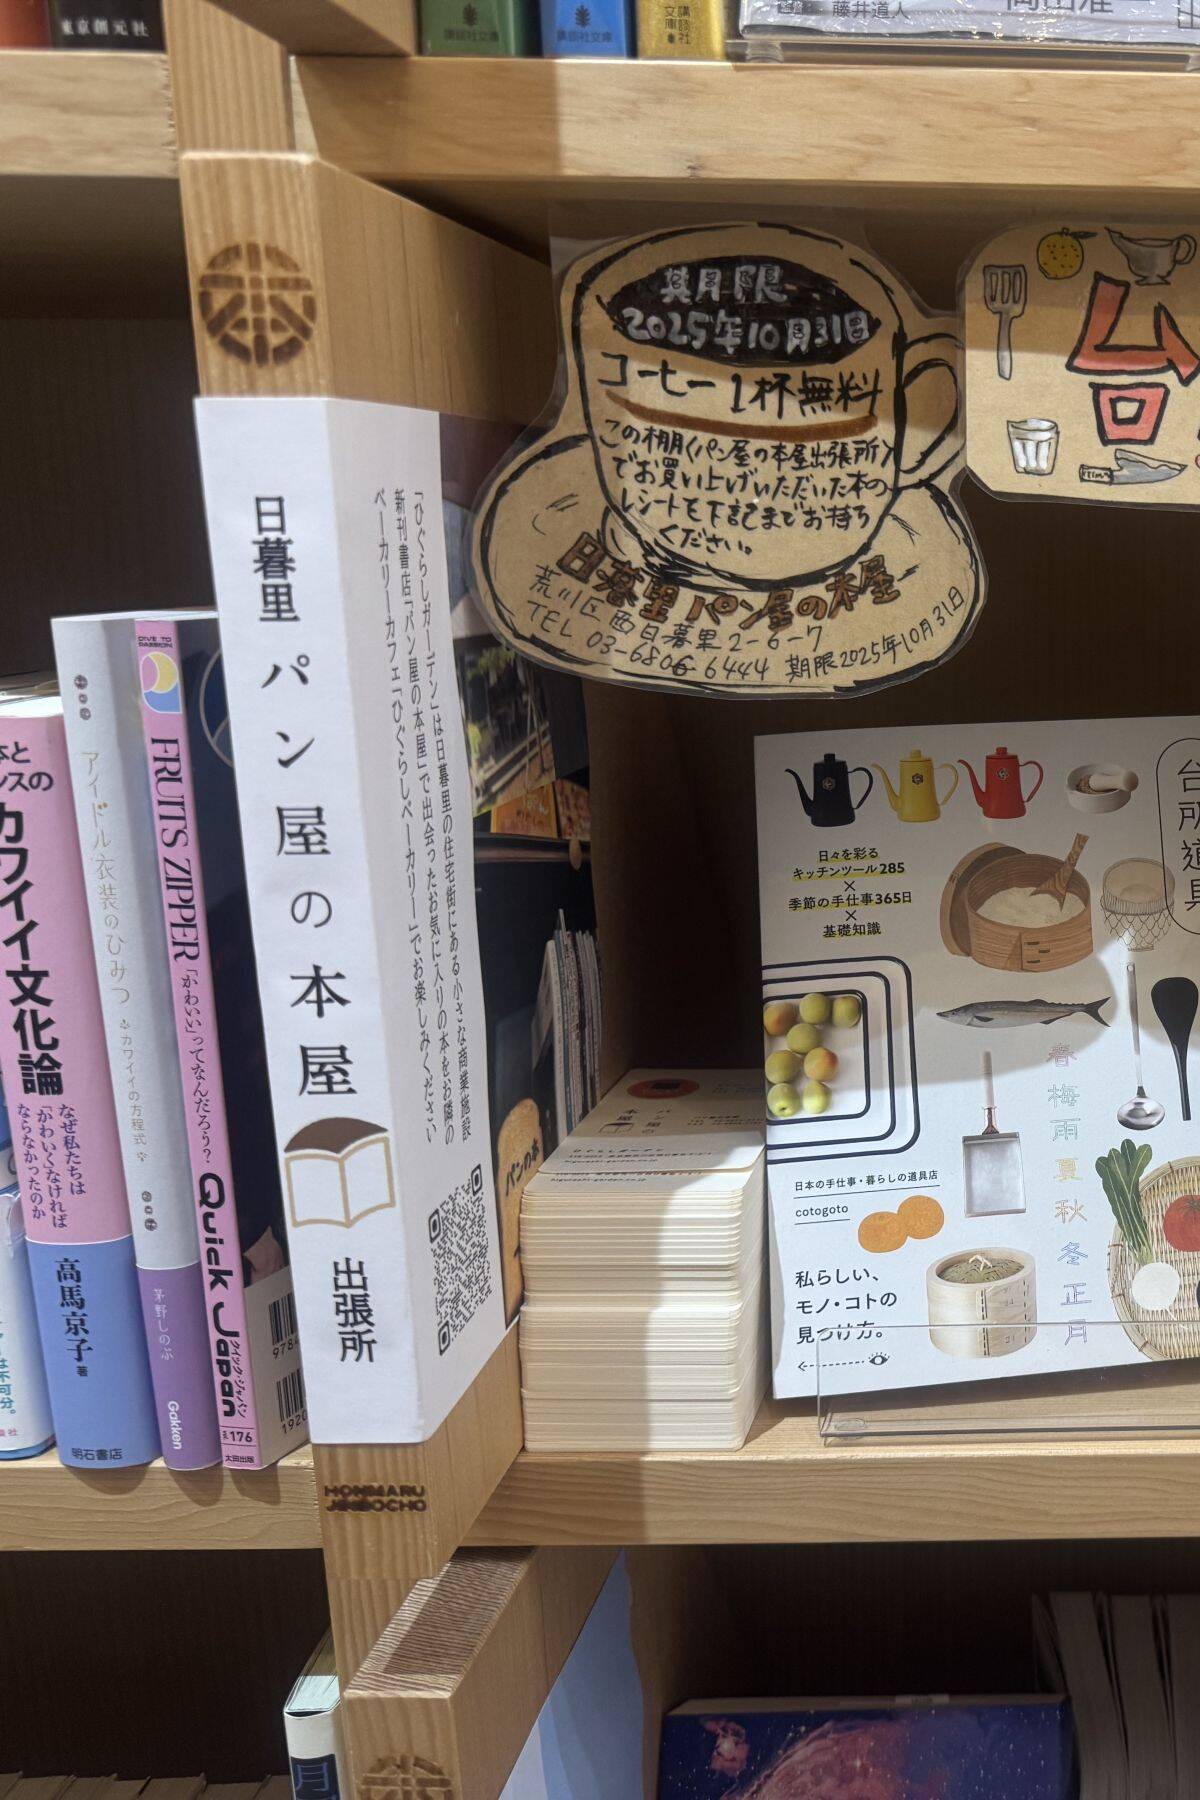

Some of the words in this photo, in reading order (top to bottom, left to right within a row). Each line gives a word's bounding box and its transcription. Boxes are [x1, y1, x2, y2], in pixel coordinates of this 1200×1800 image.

[677, 3, 692, 46] 講談社
[621, 303, 872, 356] 2025年10月31日
[613, 452, 889, 502] でお買い上げいただいた本の
[620, 486, 871, 533] レシートを下記までお持ち
[659, 524, 754, 557] ください。
[525, 598, 577, 640] TEL
[149, 735, 190, 849] FRUITS
[792, 861, 906, 880] キッチンツール285
[818, 847, 880, 862] 日々を彩る
[162, 856, 202, 963] ZIPPER
[788, 891, 913, 911] 季節の手仕事365日
[822, 922, 882, 939] 基礎知識
[17, 1102, 47, 1221] ならなかったのか
[36, 1103, 69, 1230] 「かわいく」なければ
[57, 1102, 87, 1196] なぜ私たちは
[1053, 1157, 1083, 1183] 夏
[794, 1170, 939, 1192] 日本の手仕事・暮らしの道具店
[198, 1171, 234, 1292] Quick
[794, 1204, 849, 1218] cotogoto
[1053, 1198, 1088, 1224] 秋
[1056, 1241, 1089, 1266] 冬
[795, 1267, 880, 1289] 私らしい、
[53, 1256, 94, 1363] 高馬京子
[331, 1256, 377, 1364] 出張所
[795, 1291, 898, 1315] モノ・コトの
[211, 1301, 240, 1418] Japan
[166, 1400, 183, 1451] Gakken
[230, 1431, 253, 1444] 176
